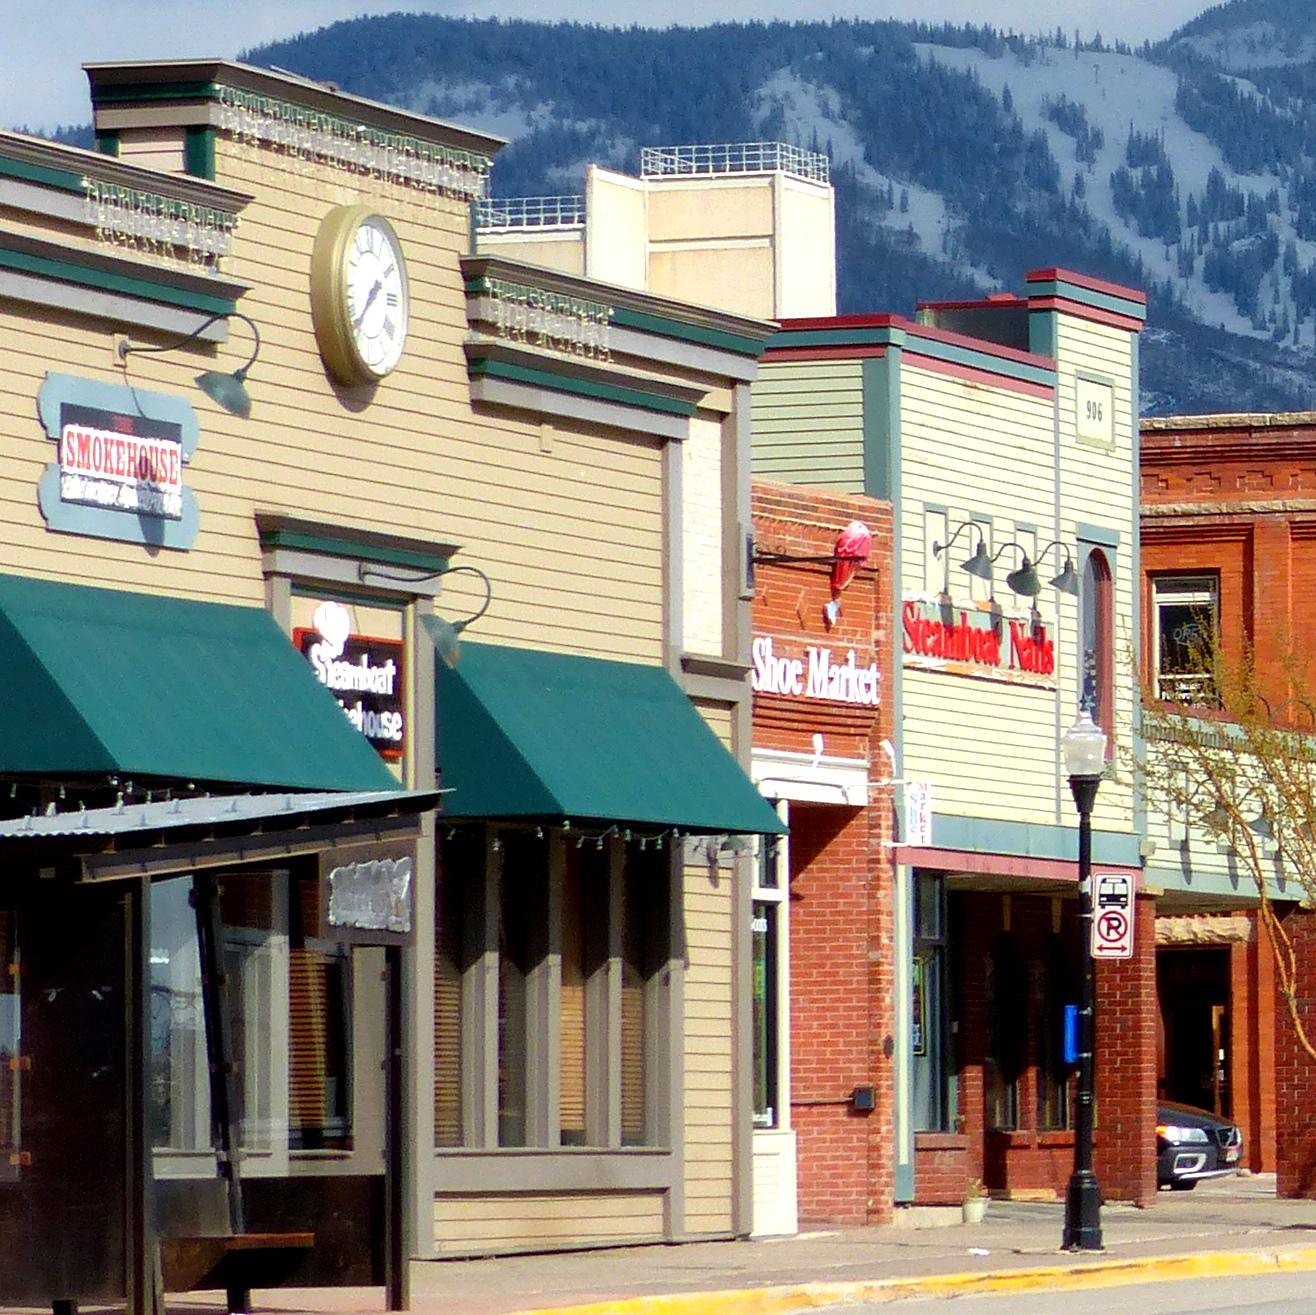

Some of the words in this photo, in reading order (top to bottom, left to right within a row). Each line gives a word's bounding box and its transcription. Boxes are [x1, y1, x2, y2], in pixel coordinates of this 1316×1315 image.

[1087, 400, 1103, 422] 906
[66, 431, 179, 485] SMOKEHOUSE
[902, 600, 1001, 667] Steamboat
[1008, 619, 1055, 675] Nails
[311, 643, 396, 695] Steamboat
[752, 637, 803, 695] Shoe
[805, 646, 880, 705] Market
